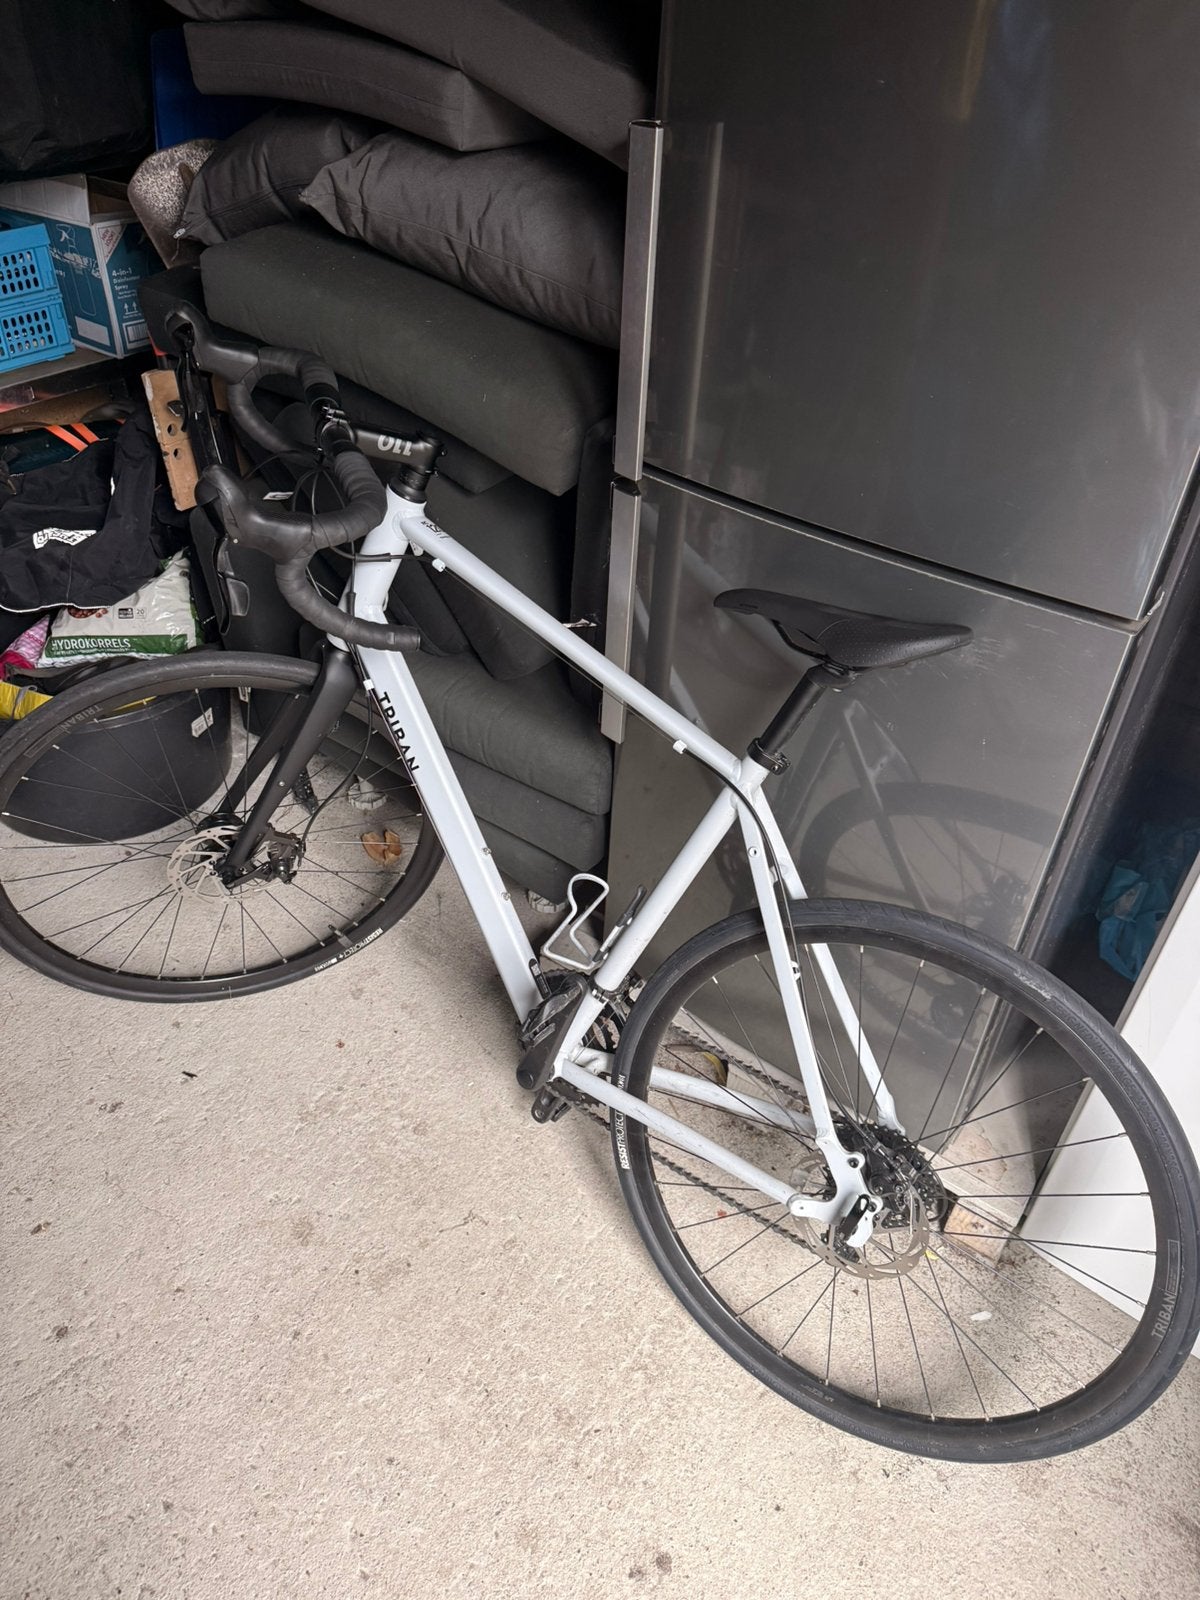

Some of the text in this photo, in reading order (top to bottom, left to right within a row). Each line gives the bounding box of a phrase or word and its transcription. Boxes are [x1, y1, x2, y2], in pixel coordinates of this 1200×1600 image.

[52, 638, 131, 650] HYDROKORRELS
[61, 704, 104, 734] TRIBAN
[1151, 1292, 1176, 1339] TRIBAN
